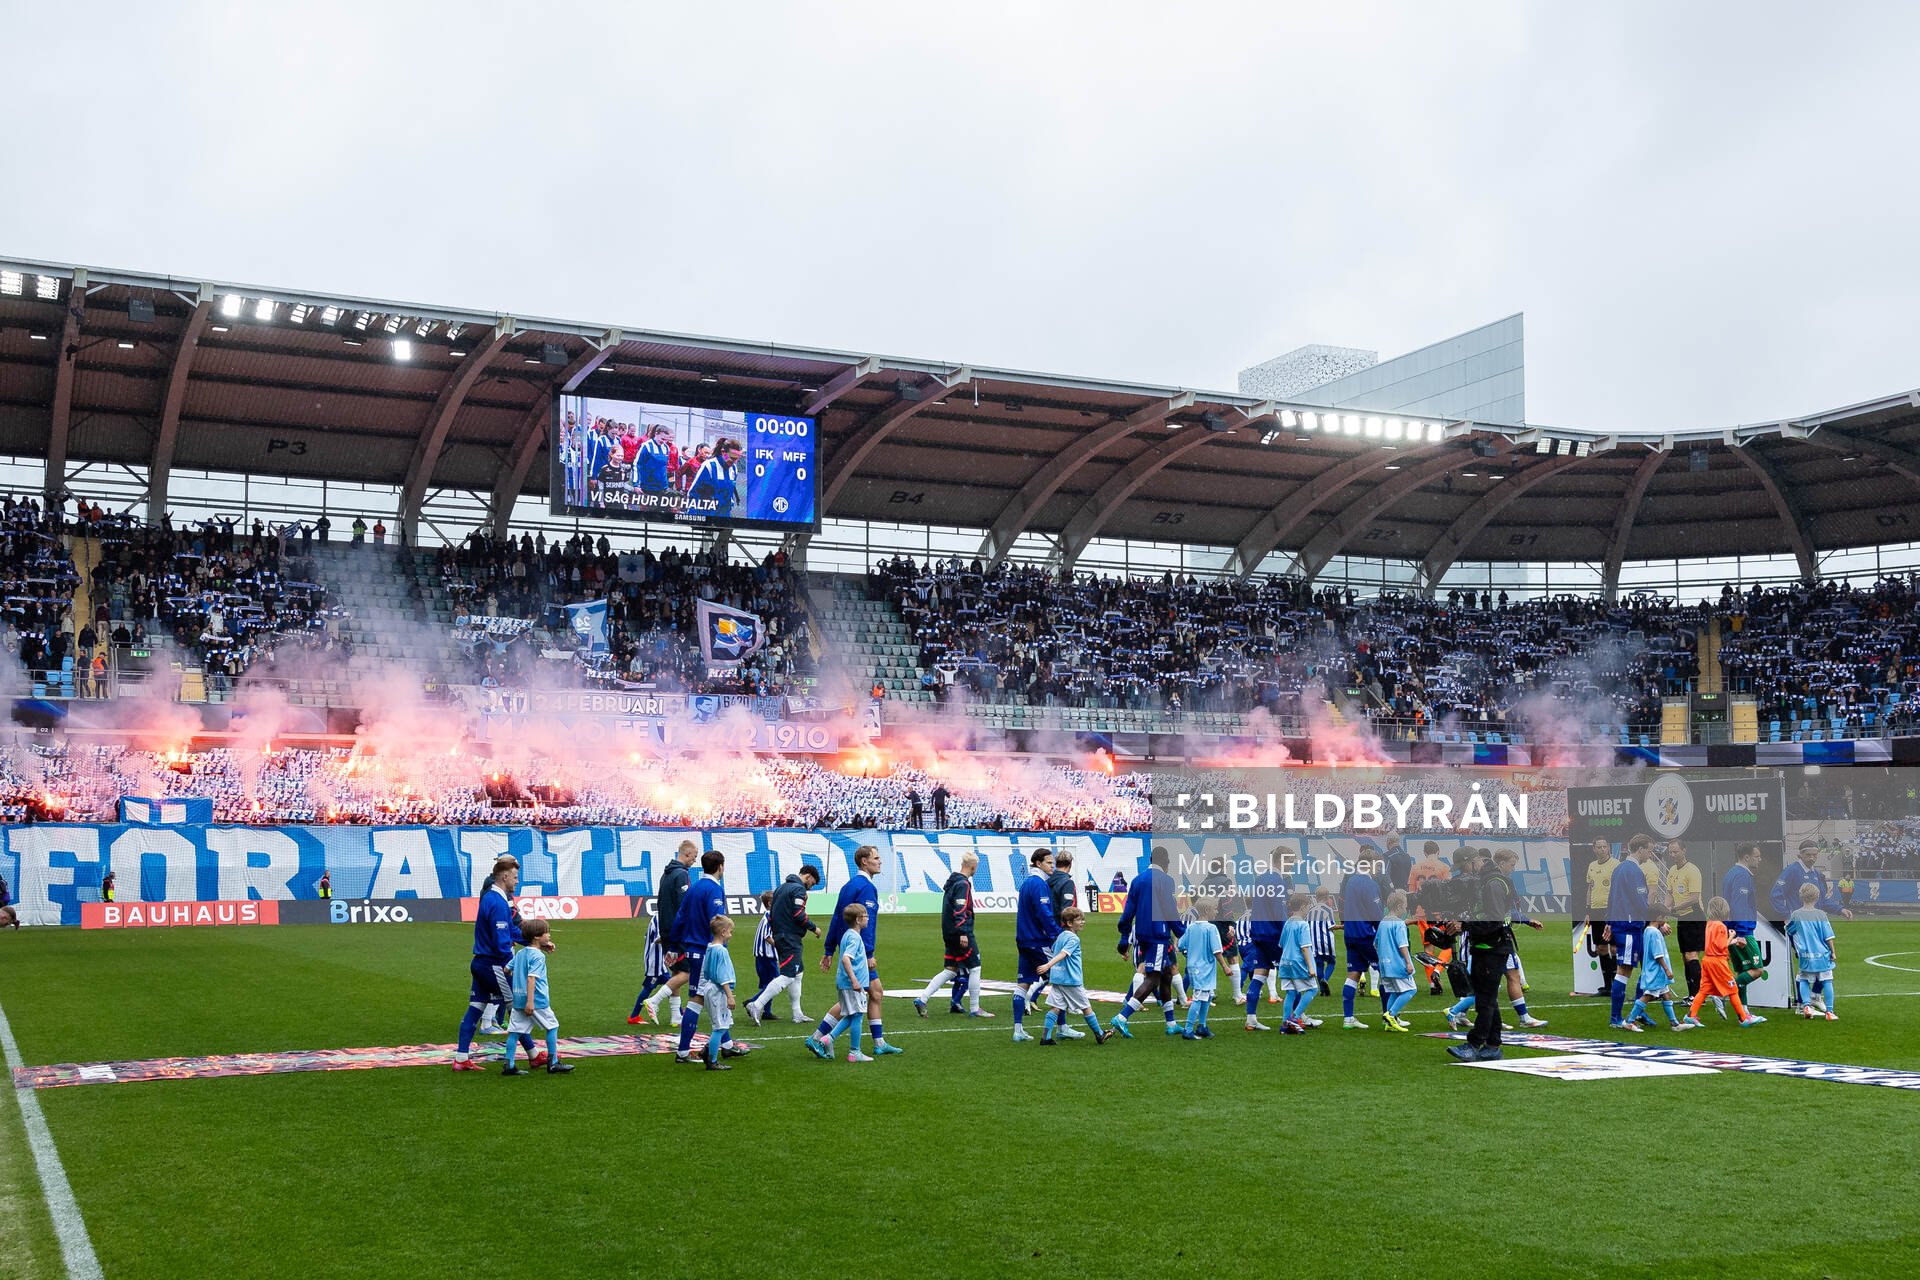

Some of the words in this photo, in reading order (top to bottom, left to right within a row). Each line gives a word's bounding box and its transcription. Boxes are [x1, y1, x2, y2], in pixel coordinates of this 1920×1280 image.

[755, 417, 808, 437] 00:00
[267, 438, 307, 456] P3
[755, 449, 774, 460] IFK
[783, 451, 807, 463] MFF
[755, 464, 765, 477] 0
[797, 468, 807, 481] 0
[591, 490, 603, 503] VI
[604, 490, 629, 504] SÅG
[632, 493, 659, 507] HUR
[660, 496, 678, 508] DU
[889, 490, 925, 506] B4
[674, 513, 707, 522] SAMSUNG
[1151, 512, 1186, 525] B3
[1508, 533, 1538, 545] B1
[568, 695, 664, 715] FEBRUARI
[765, 724, 830, 749] 1910
[1577, 798, 1633, 816] UNIBET
[1705, 792, 1769, 812] UNIBET
[8, 802, 301, 926] FÖR
[104, 901, 258, 925] BAUHAUS
[516, 896, 580, 920] GARO
